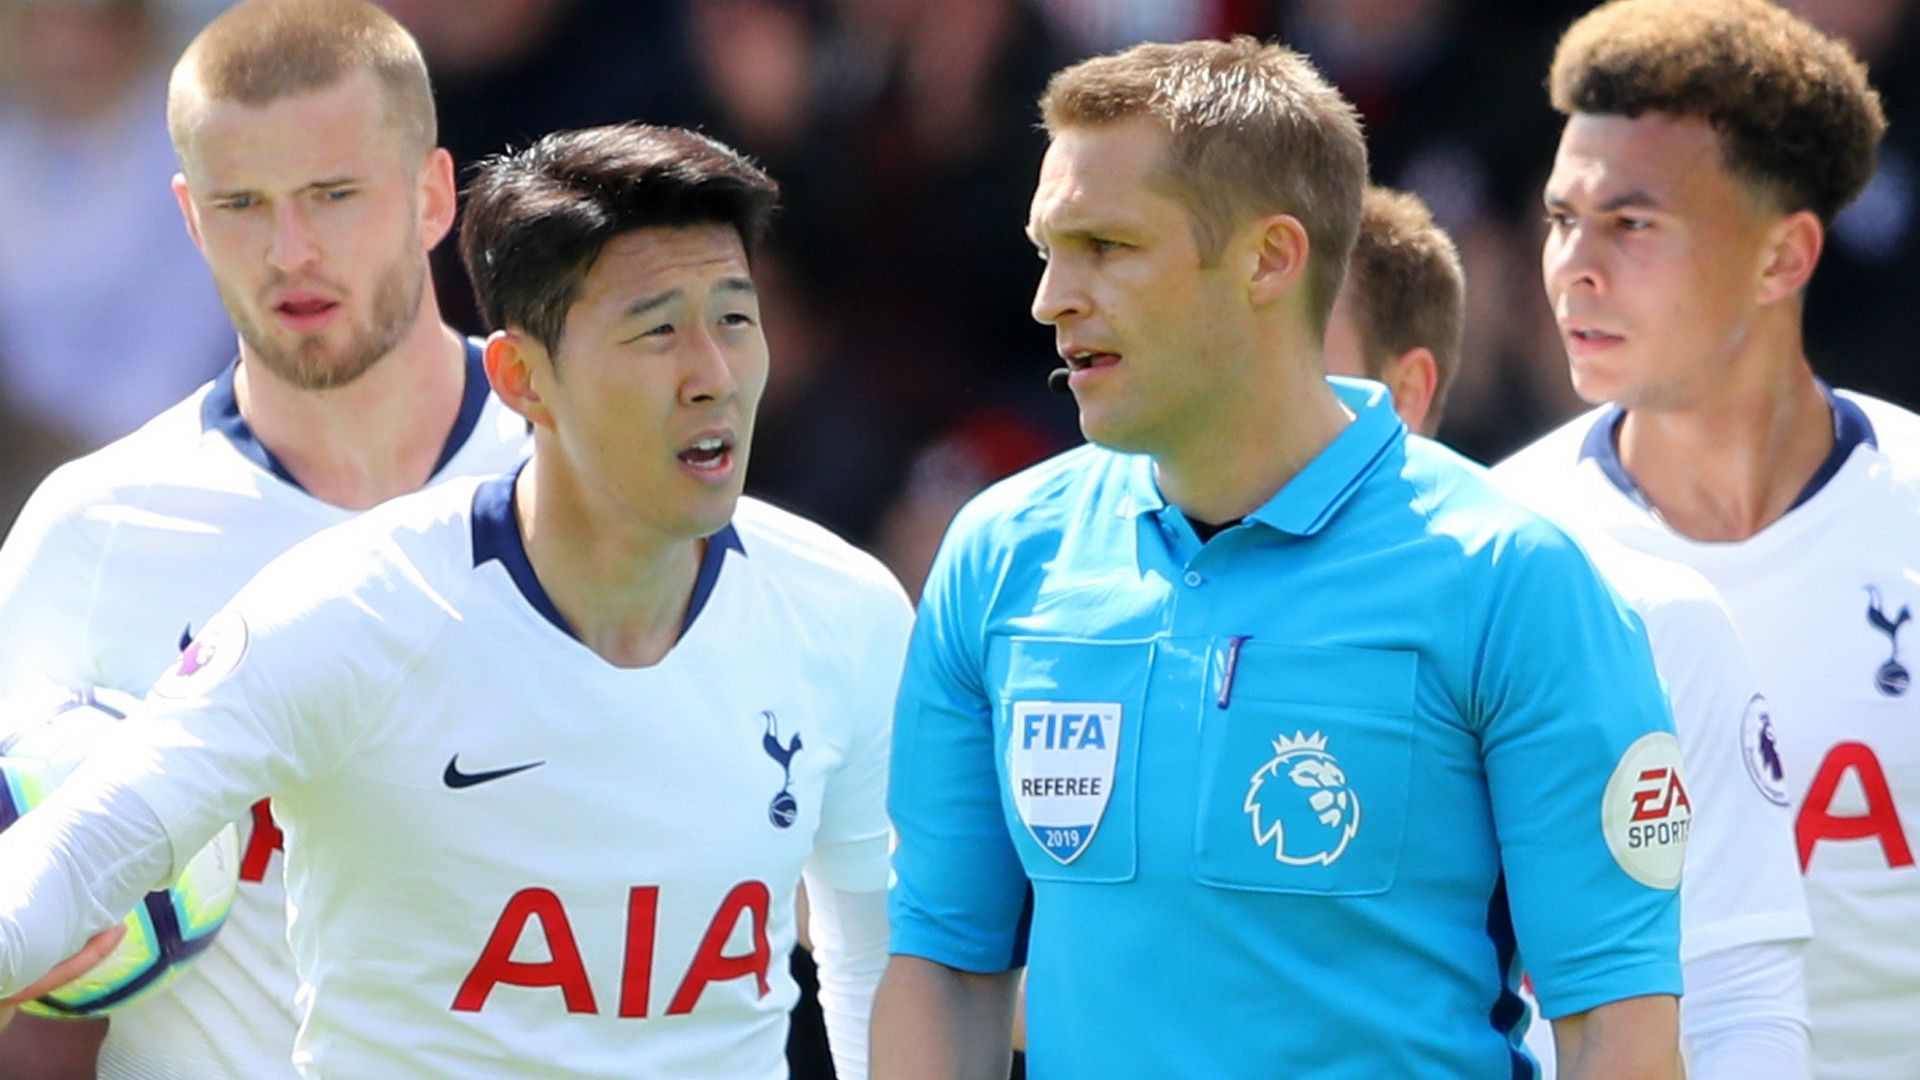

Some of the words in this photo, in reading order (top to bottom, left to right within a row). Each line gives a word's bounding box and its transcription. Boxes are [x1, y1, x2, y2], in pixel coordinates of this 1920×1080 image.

[1022, 713, 1107, 750] FIFA
[1020, 776, 1103, 797] REFEREE
[1630, 767, 1692, 822] EA
[1045, 829, 1080, 848] 2019
[450, 879, 772, 1019] AIA
